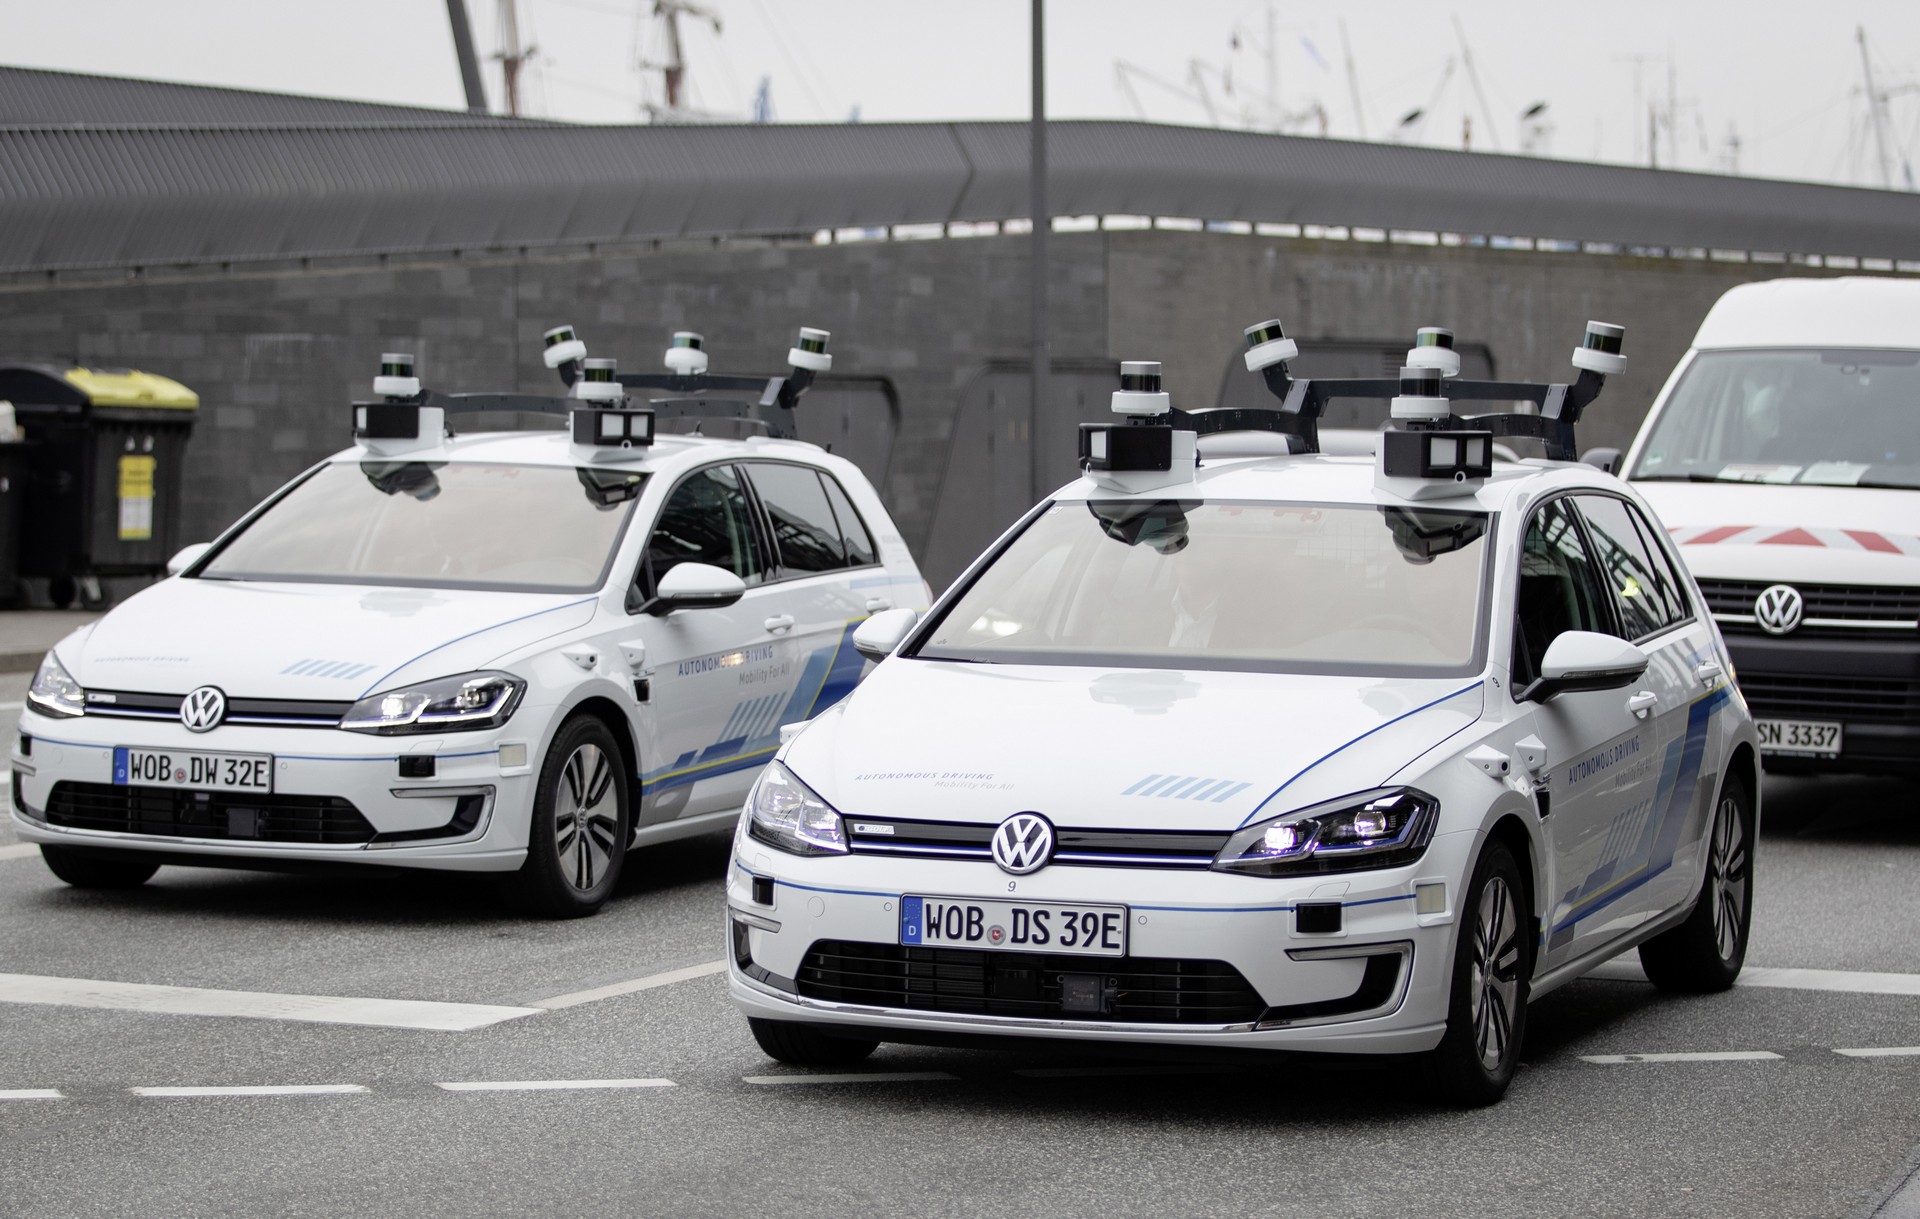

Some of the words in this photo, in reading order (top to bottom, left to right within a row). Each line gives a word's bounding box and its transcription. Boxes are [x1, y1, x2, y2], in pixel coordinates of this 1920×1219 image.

[739, 667, 768, 685] Mobility
[769, 664, 781, 680] For
[781, 663, 790, 676] All
[1757, 723, 1781, 744] SN
[1788, 723, 1838, 747] 3337
[131, 753, 171, 781] WOB
[190, 757, 218, 784] DW
[224, 759, 267, 787] 32E
[1568, 748, 1613, 785] AUTONOMOUS
[1614, 735, 1640, 763] DRIVING
[854, 772, 938, 781] AUTONOMOUS
[941, 772, 995, 781] DRIVING
[934, 780, 978, 790] Mobility
[979, 781, 997, 790] For
[908, 925, 916, 936] D
[925, 903, 984, 941] WOB
[1011, 908, 1050, 945] DS
[1060, 911, 1121, 949] 39E
